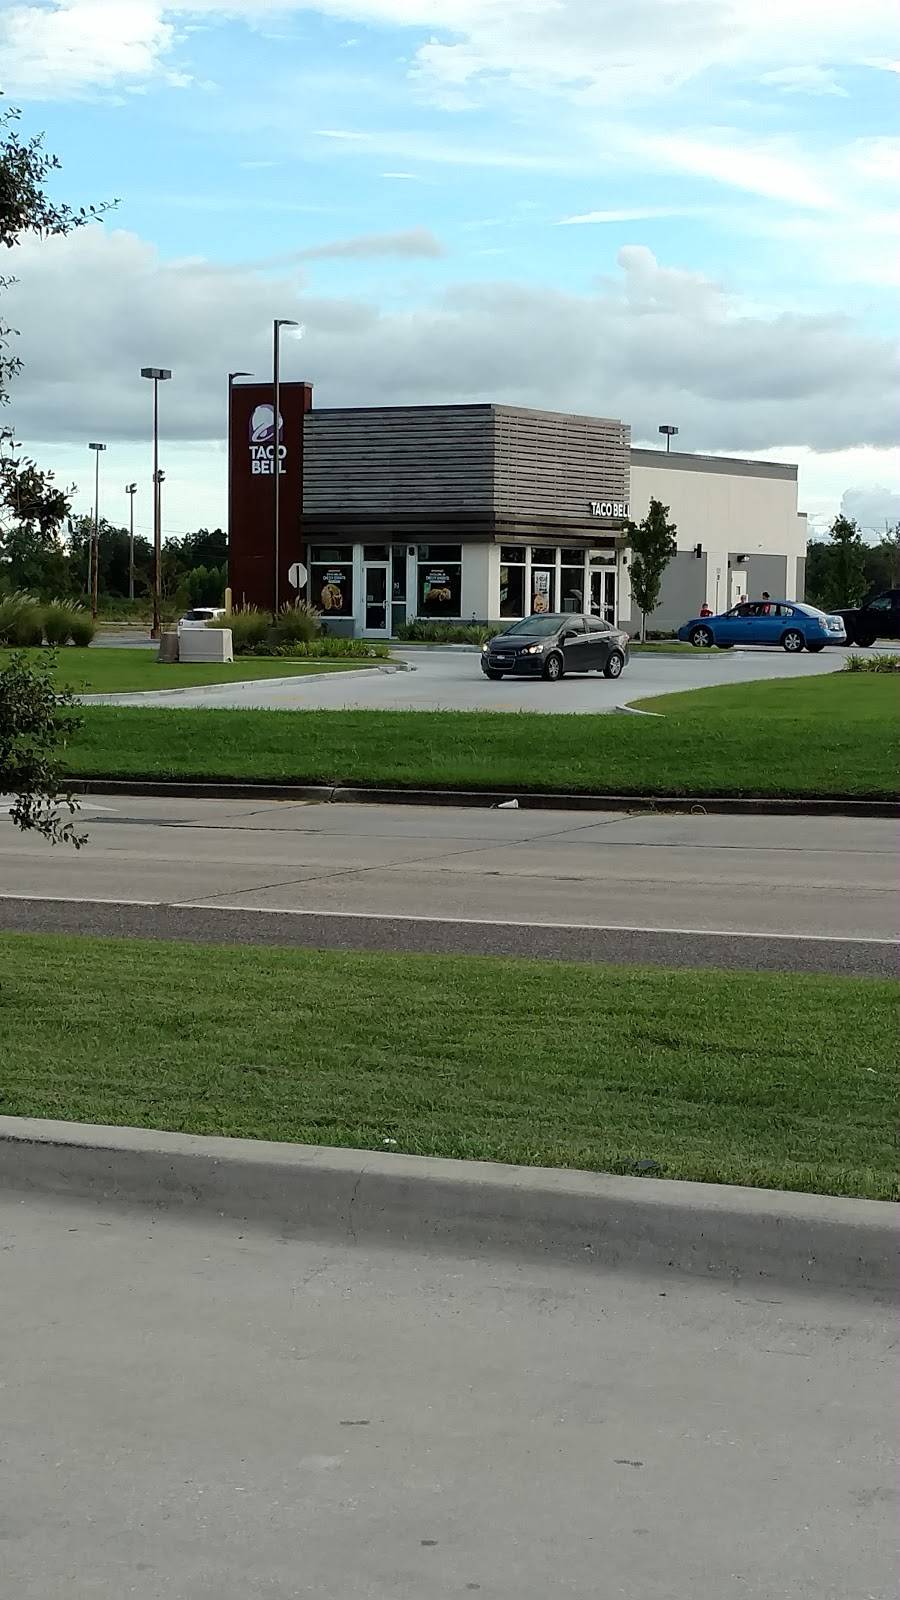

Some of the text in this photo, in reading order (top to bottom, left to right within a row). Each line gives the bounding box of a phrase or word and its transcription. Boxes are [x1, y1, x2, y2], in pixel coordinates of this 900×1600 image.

[249, 445, 287, 459] TACO
[591, 502, 631, 517] TACO BELL
